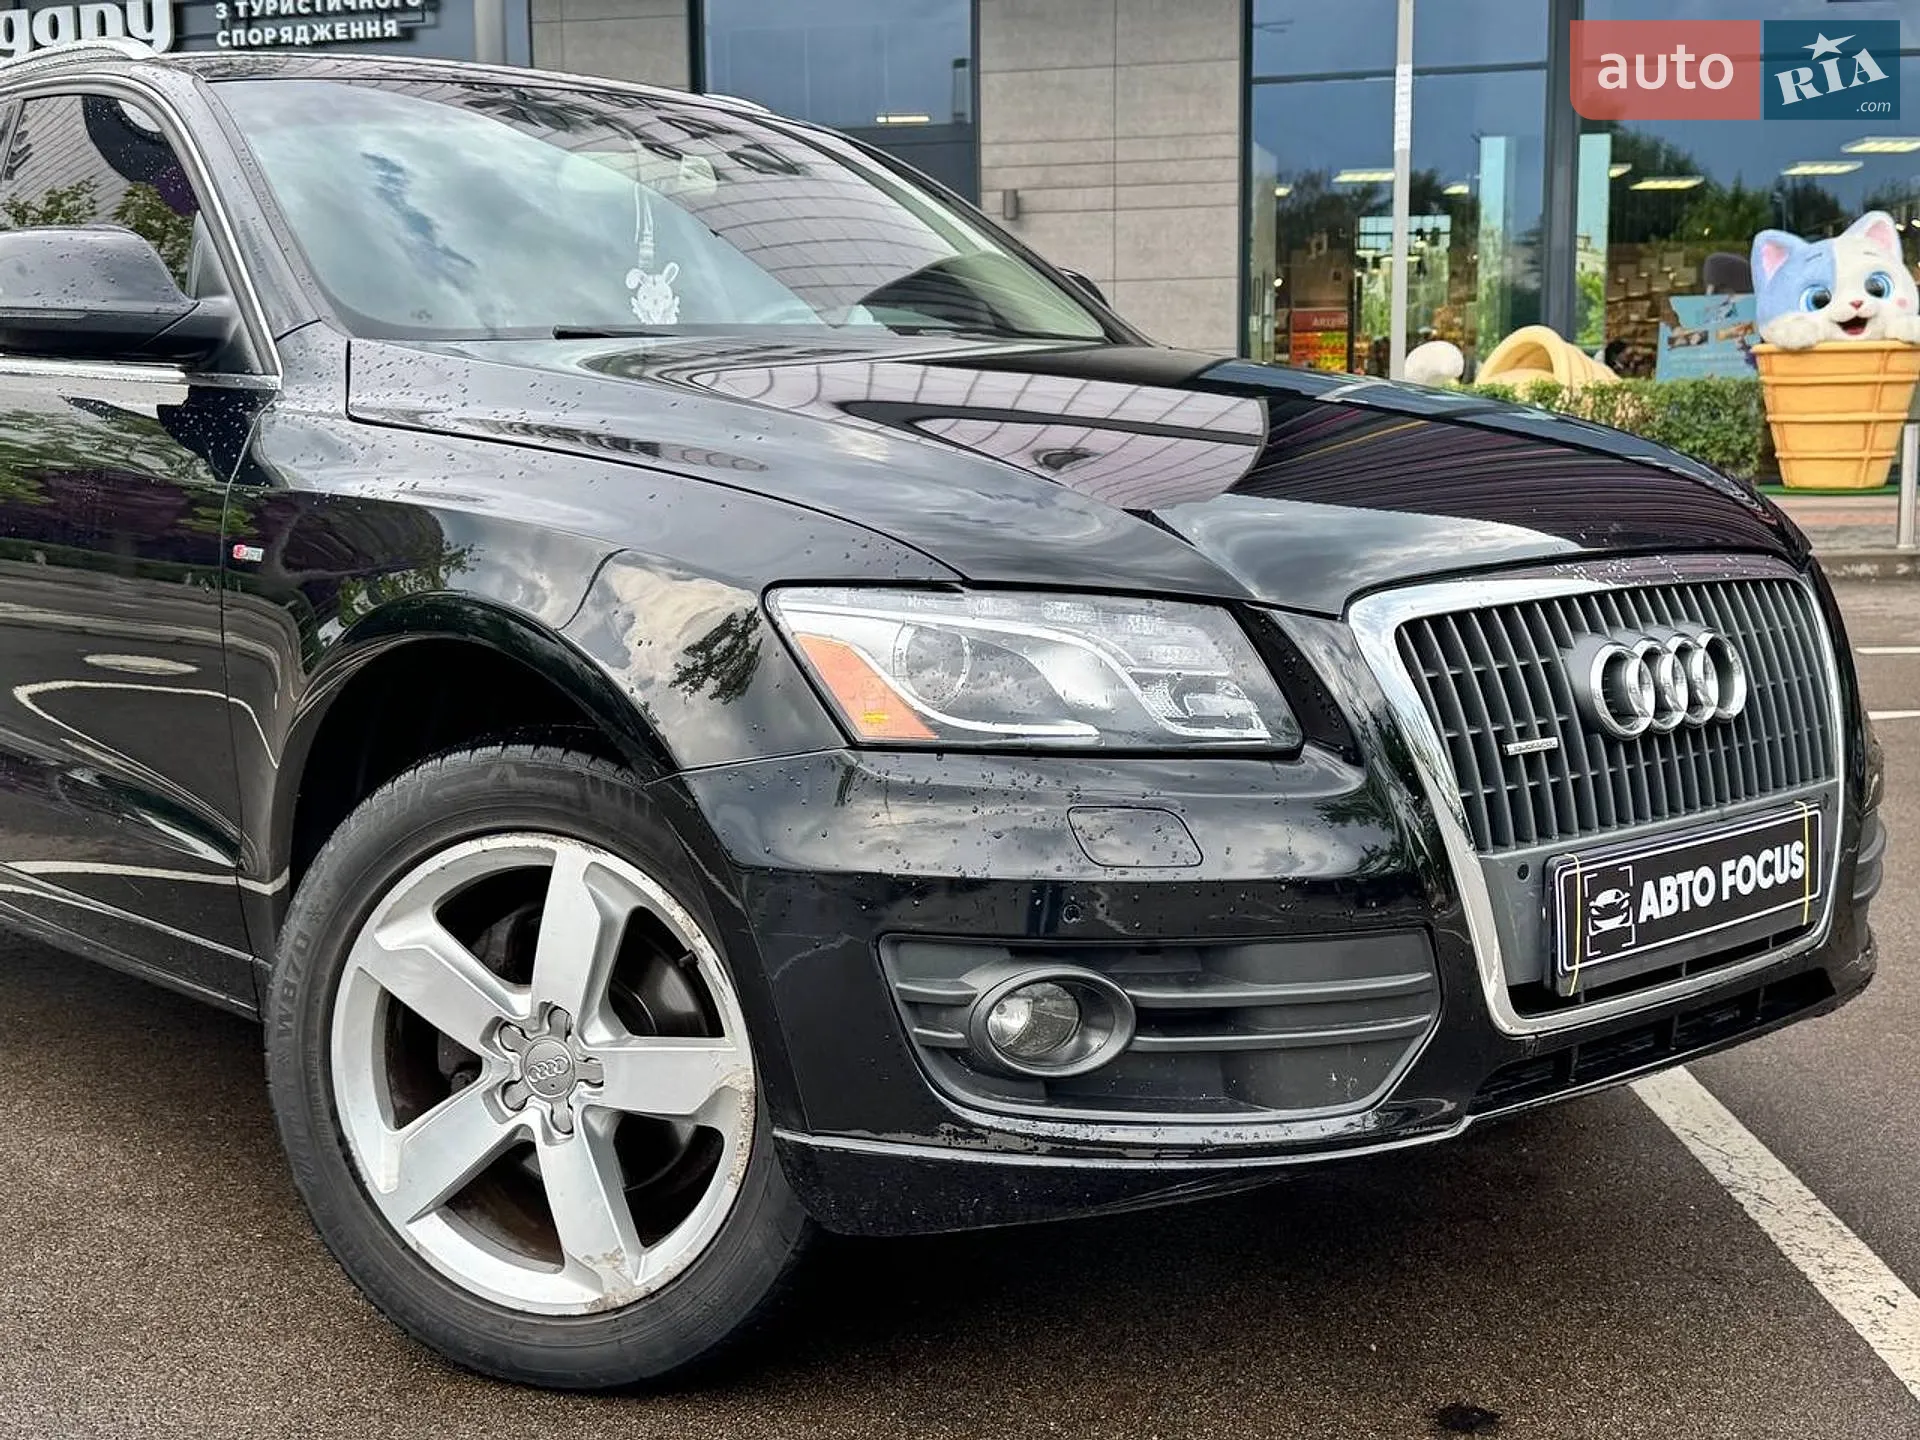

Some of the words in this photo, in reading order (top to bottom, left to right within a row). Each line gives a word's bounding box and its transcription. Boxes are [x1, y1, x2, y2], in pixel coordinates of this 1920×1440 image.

[216, 20, 399, 48] СПОРЯДЖЕННЯ
[1638, 865, 1717, 924] АВТО
[1721, 840, 1805, 902] FOCUS
